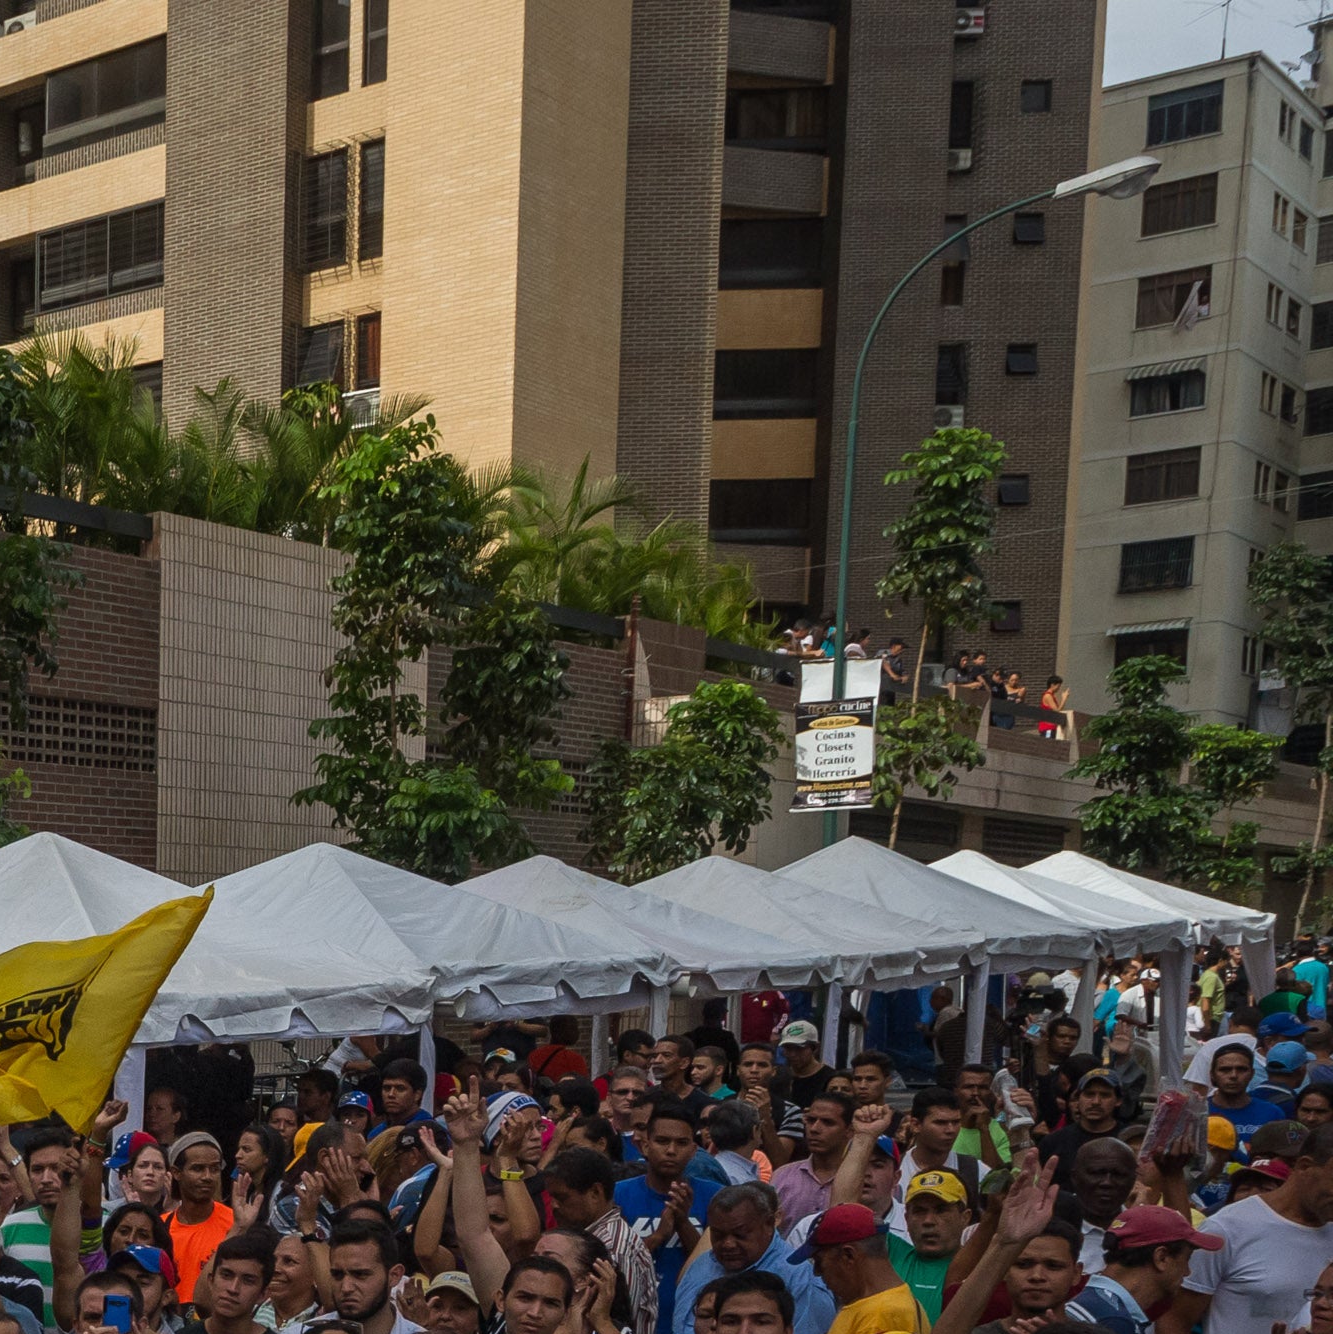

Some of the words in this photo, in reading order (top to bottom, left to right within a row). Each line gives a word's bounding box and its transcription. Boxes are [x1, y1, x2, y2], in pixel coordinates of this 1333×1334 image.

[815, 730, 856, 741] Cocinas
[816, 743, 854, 753] Closets
[815, 755, 856, 766] Granito
[812, 766, 857, 779] Herrería
